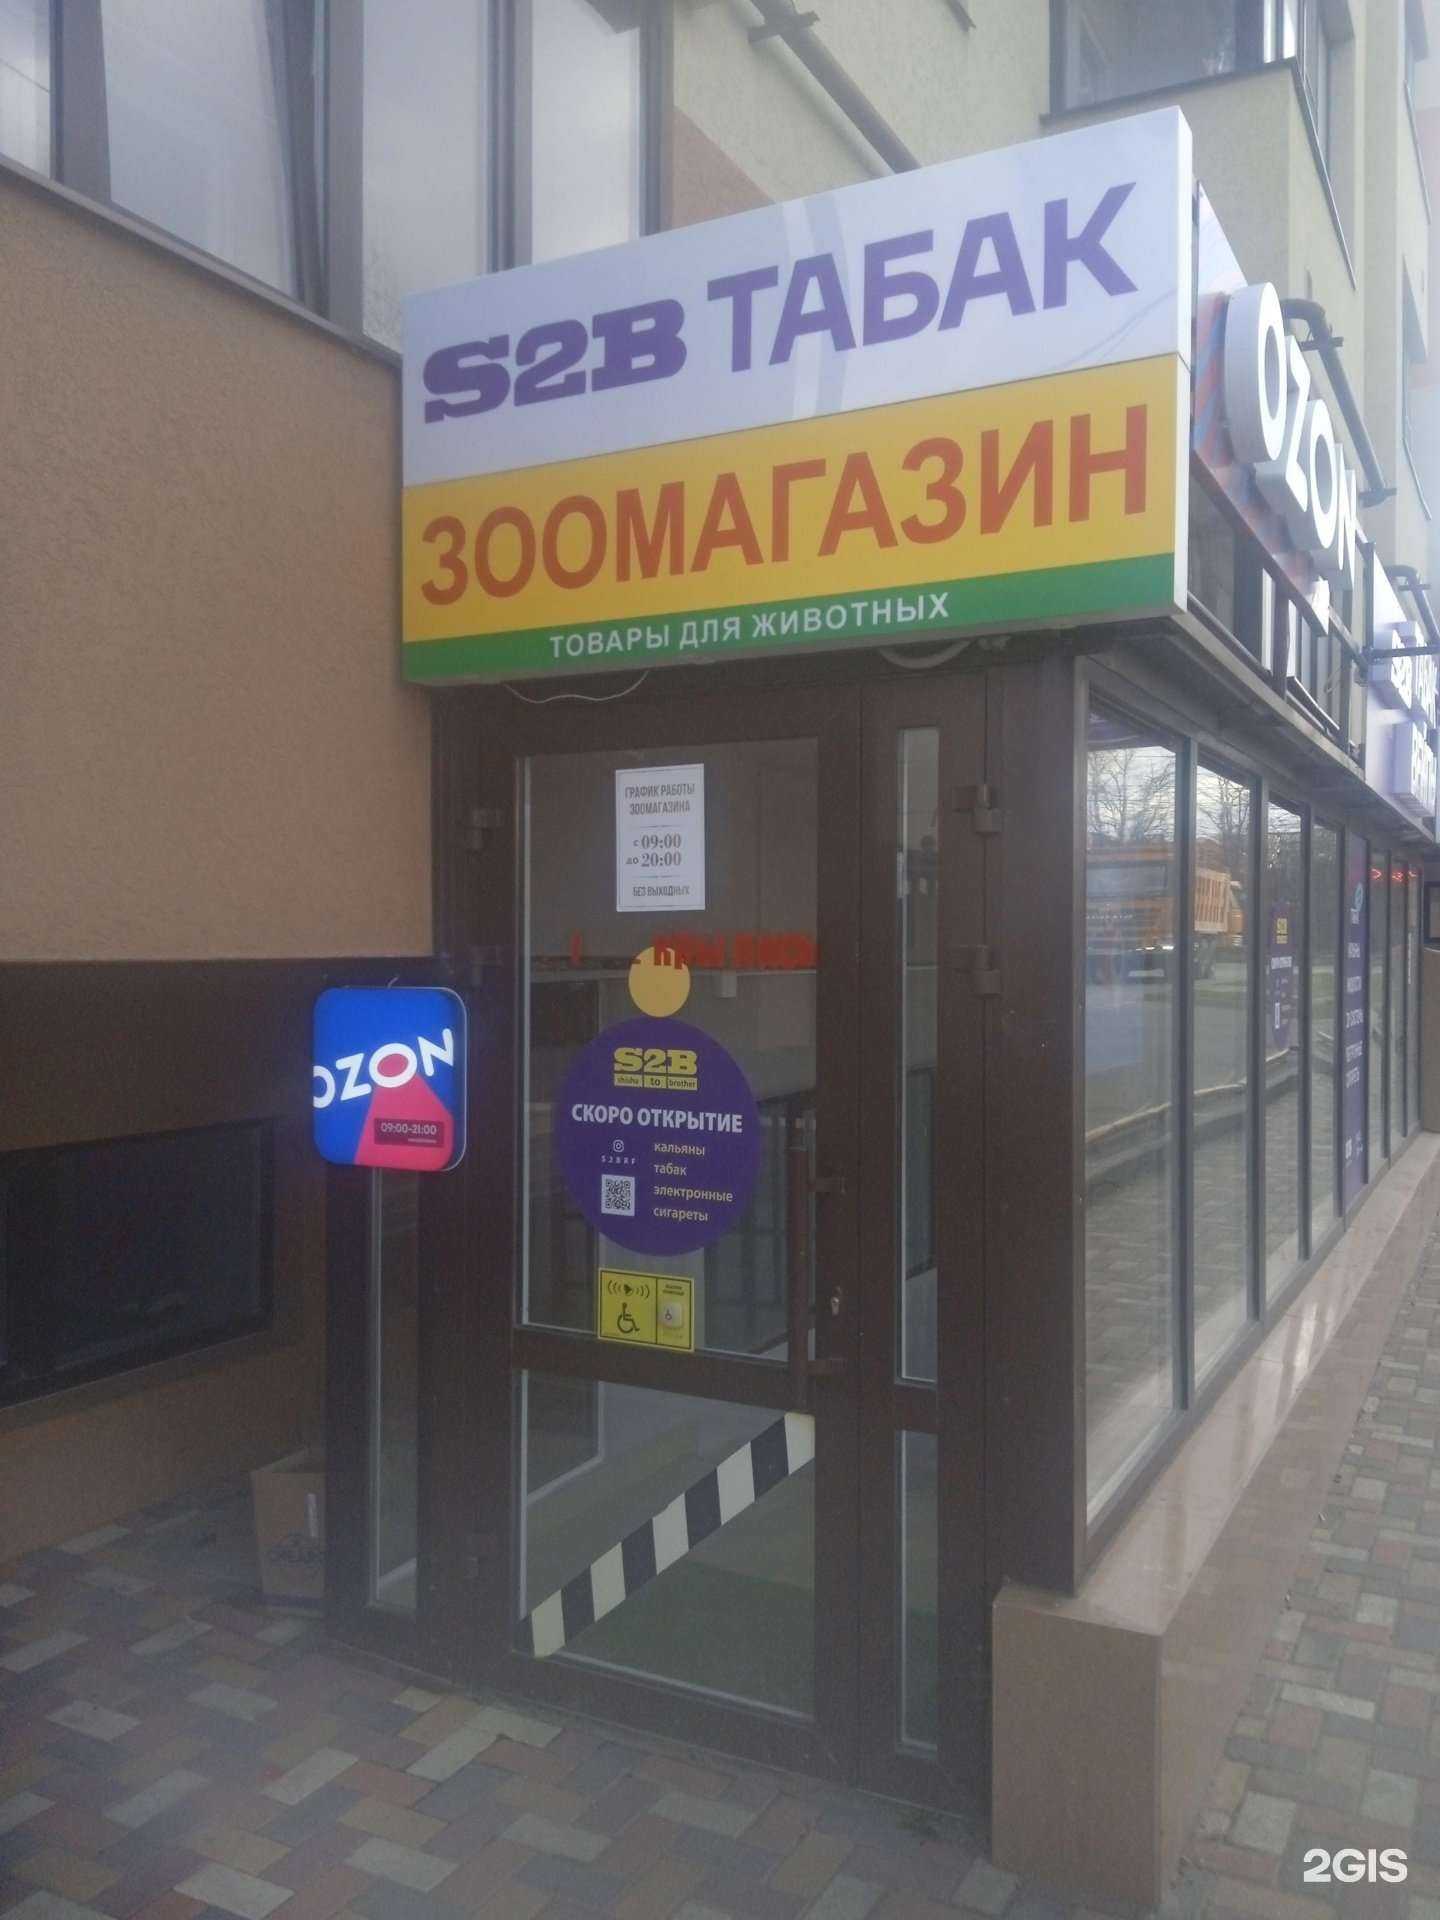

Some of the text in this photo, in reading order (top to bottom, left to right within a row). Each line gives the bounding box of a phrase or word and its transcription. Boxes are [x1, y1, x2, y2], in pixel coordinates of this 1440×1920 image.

[422, 182, 1138, 423] S2B ТАБАК
[1250, 281, 1357, 591] OZON
[420, 403, 1148, 606] ЗООМАГАЗИН
[550, 592, 951, 659] ТОВАРЫ ДЛЯ ЖИВОТНЫХ
[625, 783, 696, 799] ГРАФИК РАБОТЫ
[629, 800, 690, 815] ЗООМАГАЗИНА
[641, 833, 682, 849] 09:00
[626, 852, 682, 867] до 20:00
[632, 885, 690, 896] БЕЗ ВЫХОДНЫХ
[313, 1028, 454, 1108] OZON
[613, 1047, 698, 1075] S2B
[649, 1077, 661, 1087] to
[668, 1078, 696, 1089] brother
[571, 1103, 743, 1133] СКОРО ОТКРЫТИЕ
[653, 1142, 706, 1156] кальяны
[653, 1163, 687, 1176] табак
[653, 1186, 734, 1203] электронные
[653, 1207, 709, 1222] сигареты
